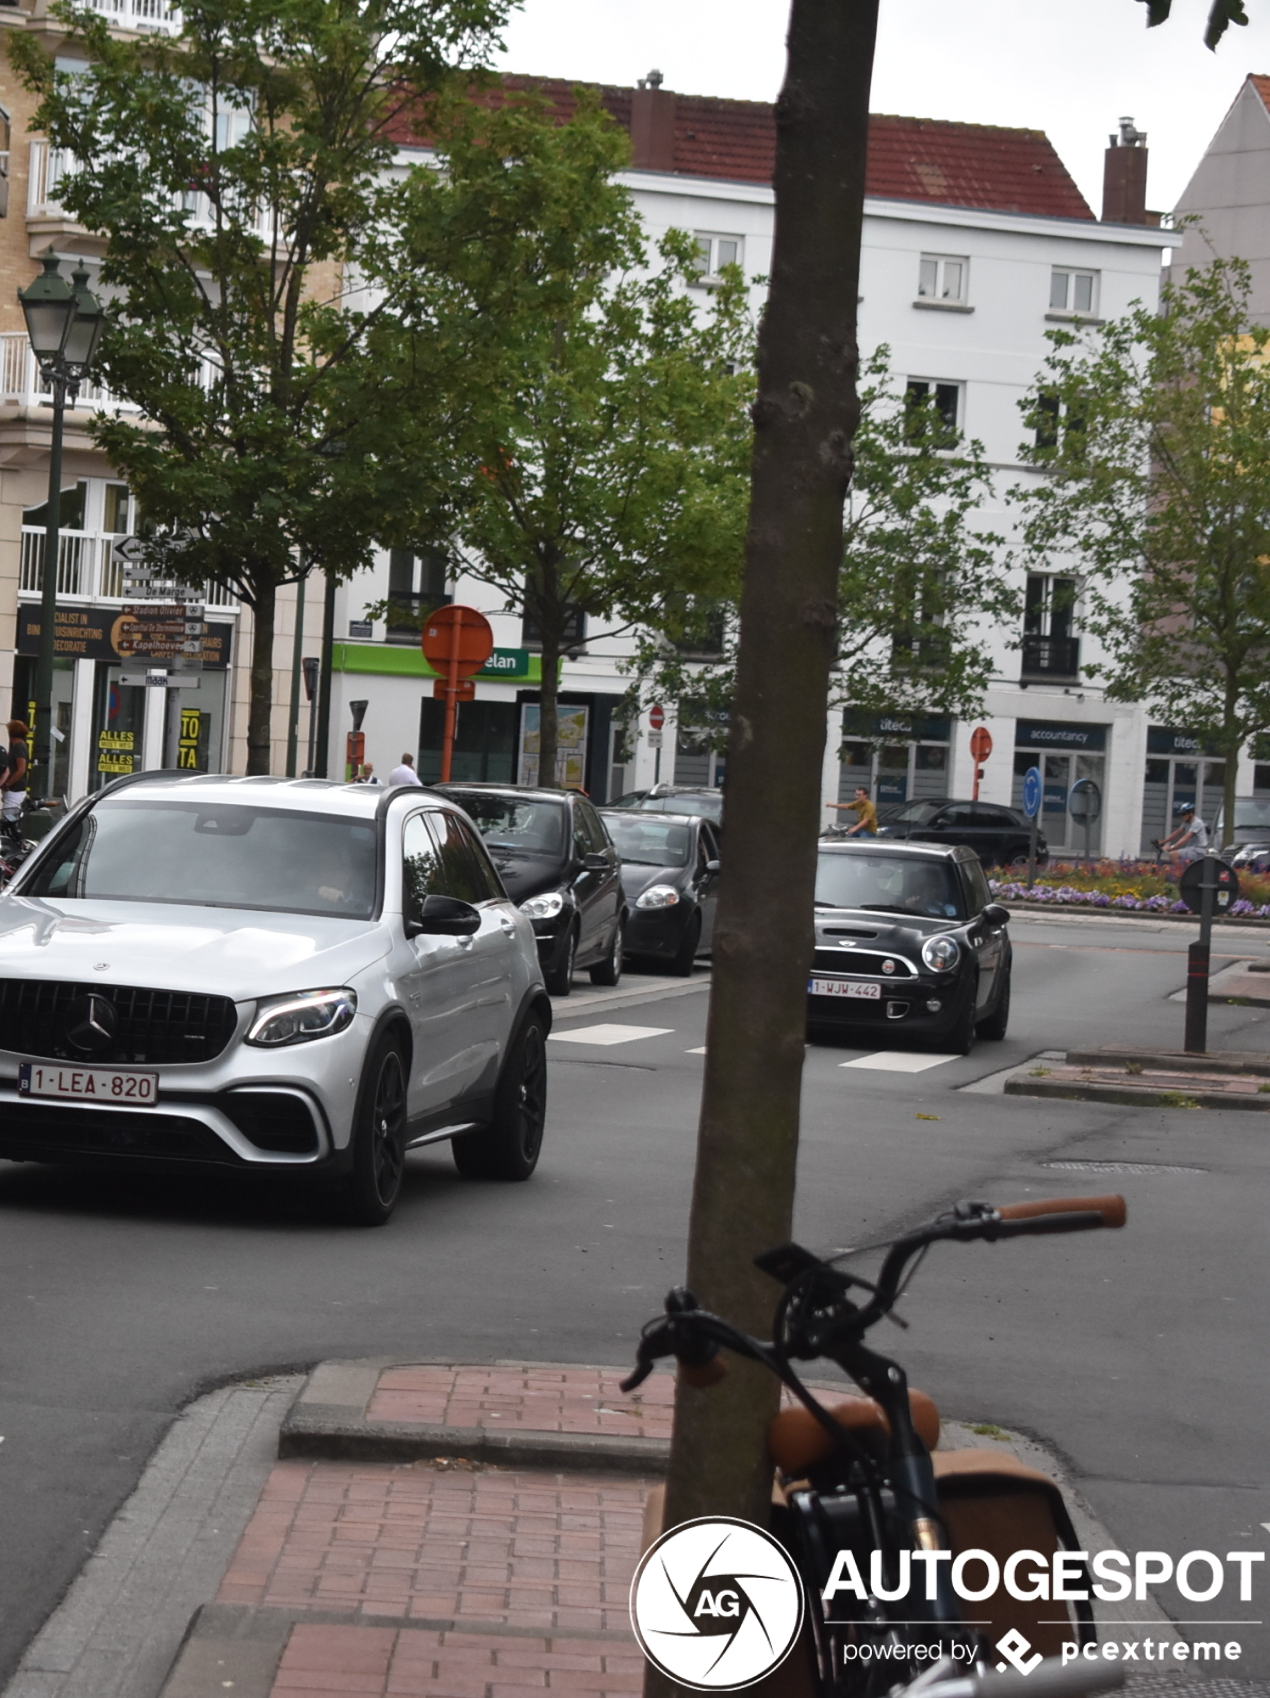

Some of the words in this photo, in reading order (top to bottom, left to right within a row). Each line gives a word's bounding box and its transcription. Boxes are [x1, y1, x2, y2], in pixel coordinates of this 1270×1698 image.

[146, 587, 157, 596] De
[159, 588, 185, 597] Marge
[132, 605, 158, 615] Stadion
[100, 730, 134, 742] ALLES
[1030, 728, 1088, 743] accountancy
[99, 753, 133, 765] ALLES
[814, 981, 878, 997] 1-WJW-442
[20, 1079, 29, 1089] B
[35, 1069, 151, 1099] 1-LEA-820
